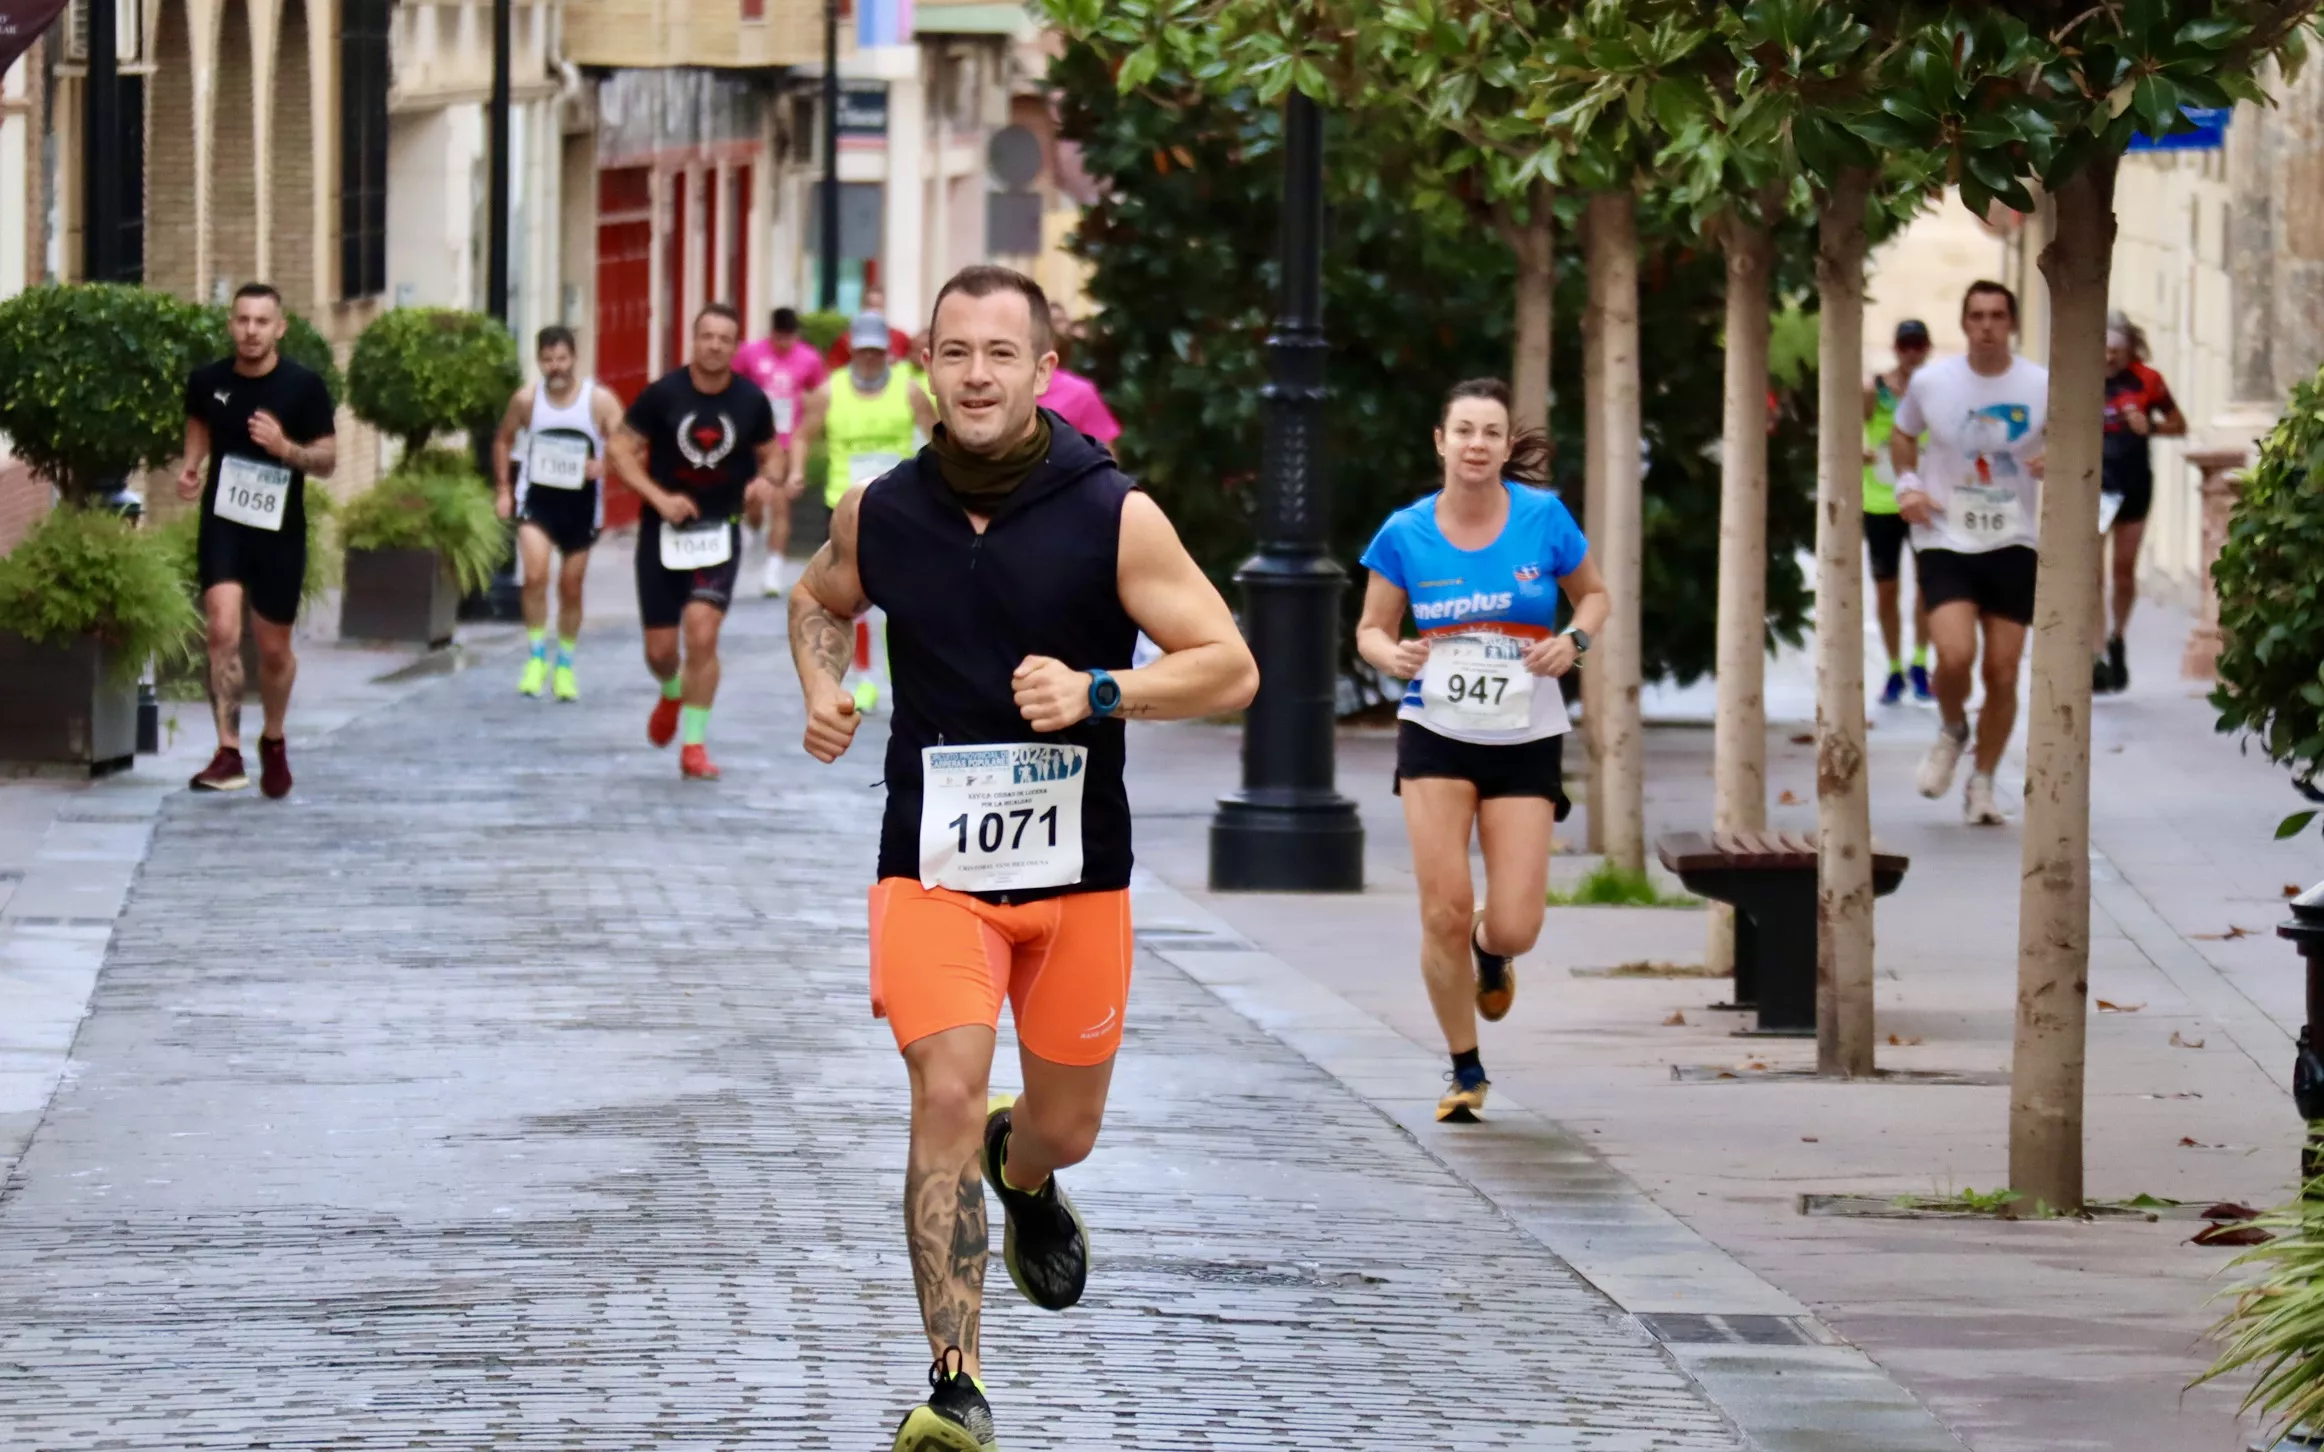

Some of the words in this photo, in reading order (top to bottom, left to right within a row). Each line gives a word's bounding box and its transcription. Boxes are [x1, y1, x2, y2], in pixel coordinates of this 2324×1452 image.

[228, 486, 276, 513] 1058
[1964, 511, 2005, 530] 816
[1447, 673, 1509, 706] 947
[1011, 748, 1051, 766] 2024
[948, 805, 1058, 854] 1071
